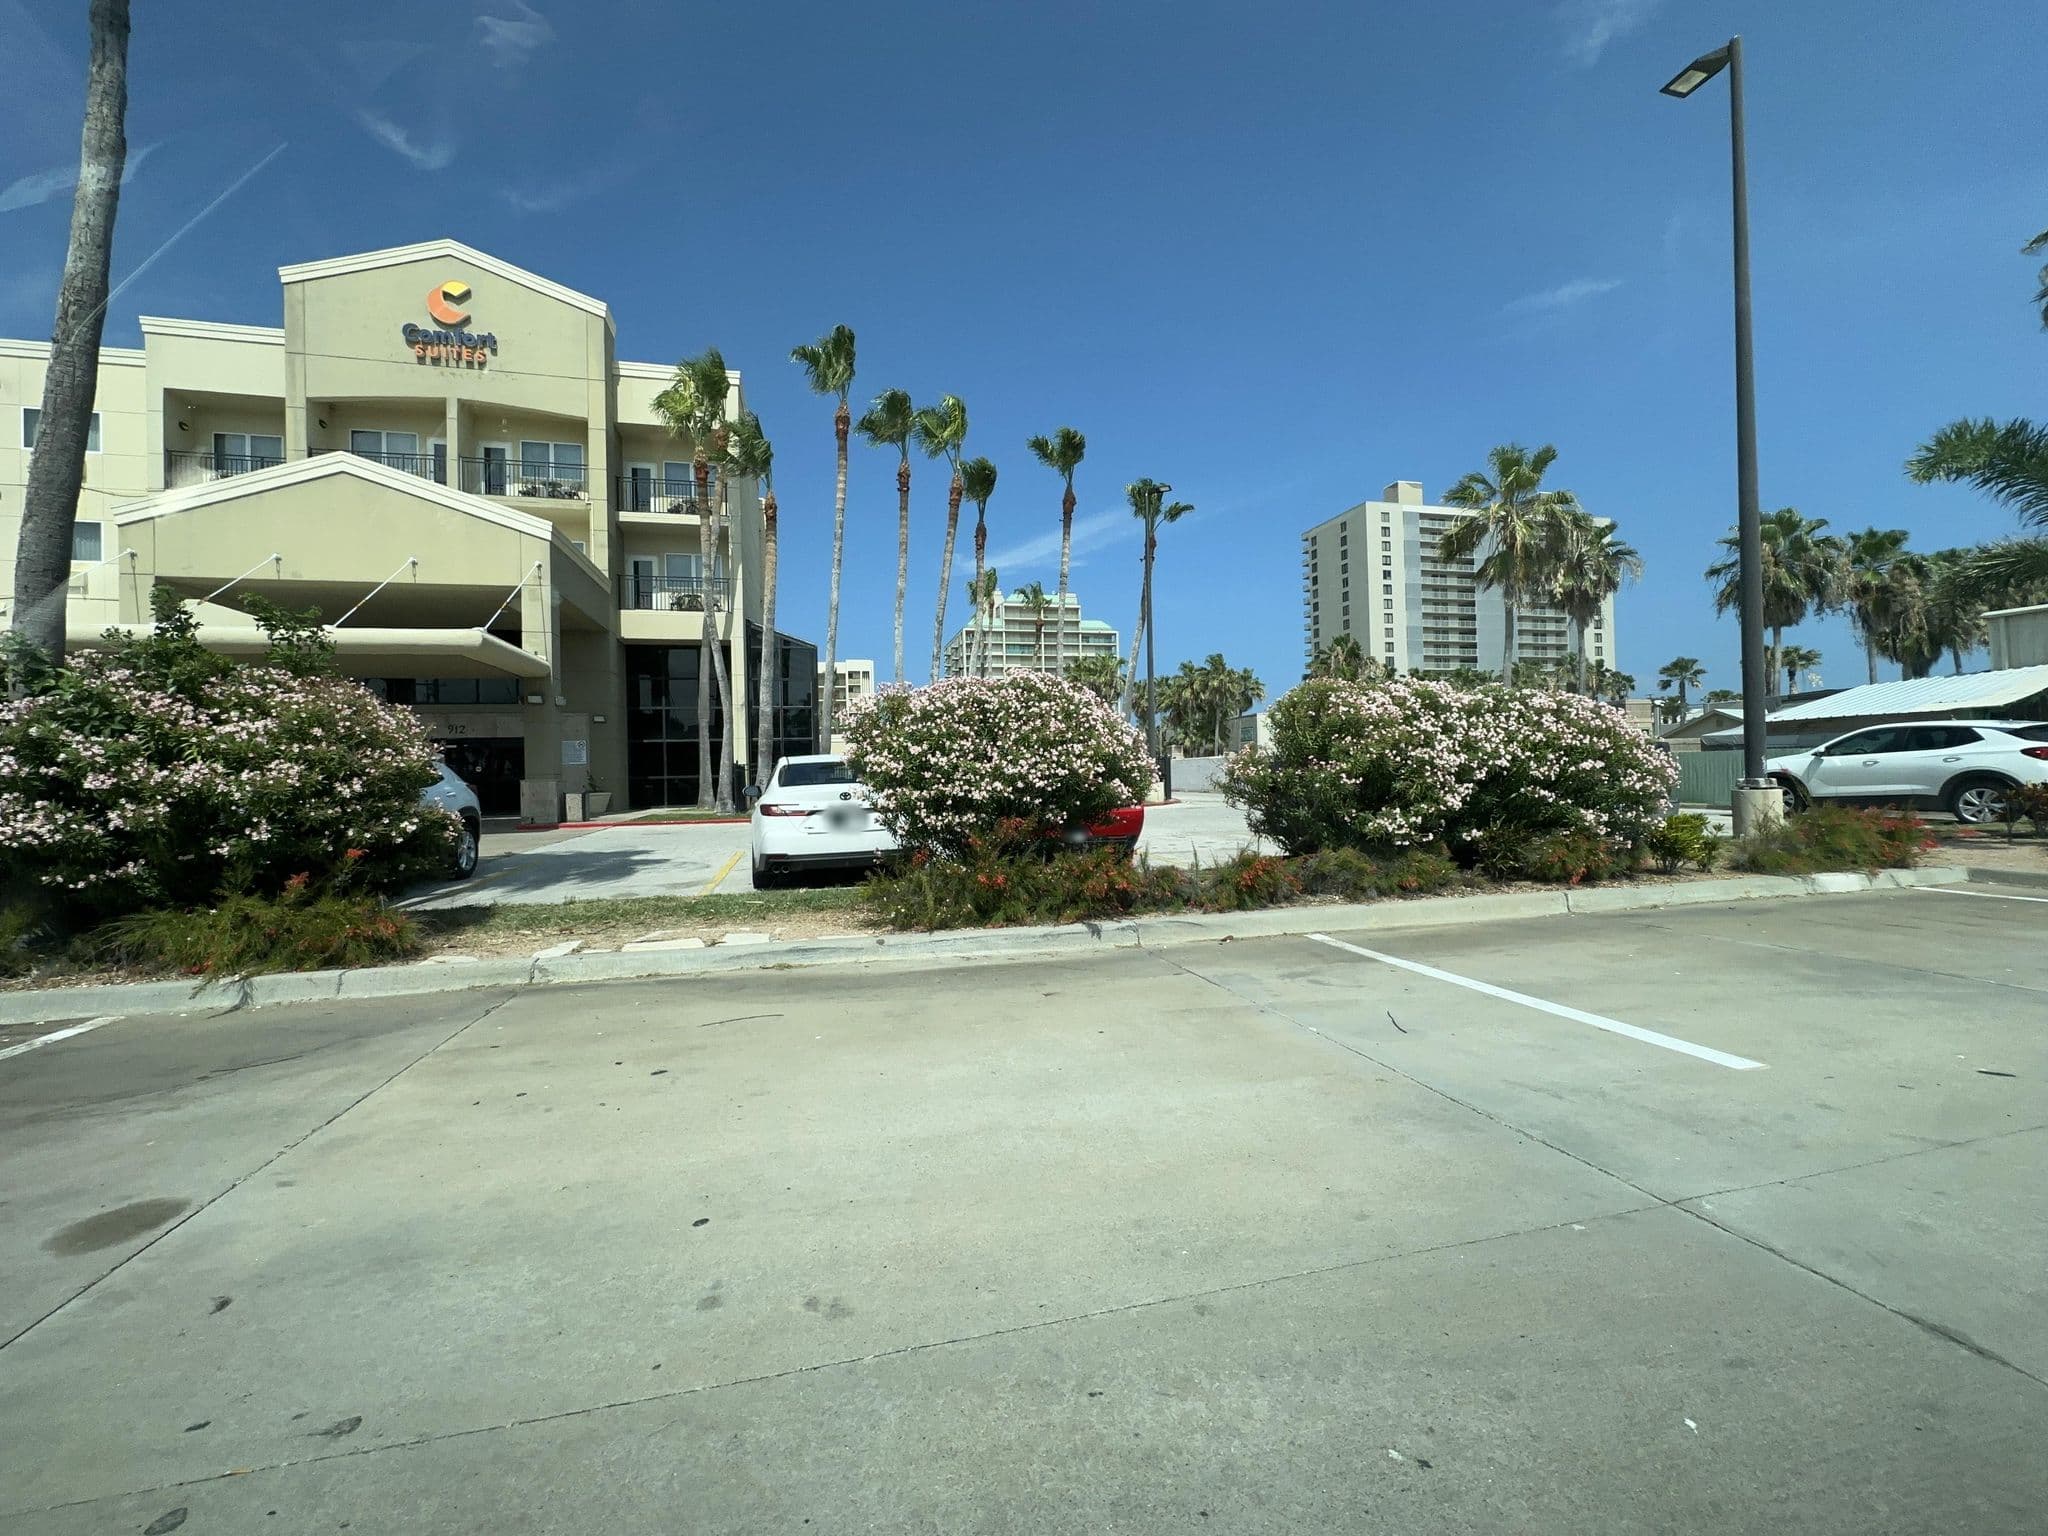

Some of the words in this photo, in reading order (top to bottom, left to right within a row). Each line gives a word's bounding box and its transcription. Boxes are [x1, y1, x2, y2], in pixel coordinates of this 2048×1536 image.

[402, 323, 497, 349] Comfort
[415, 344, 487, 363] SUITES
[447, 724, 466, 735] 912
